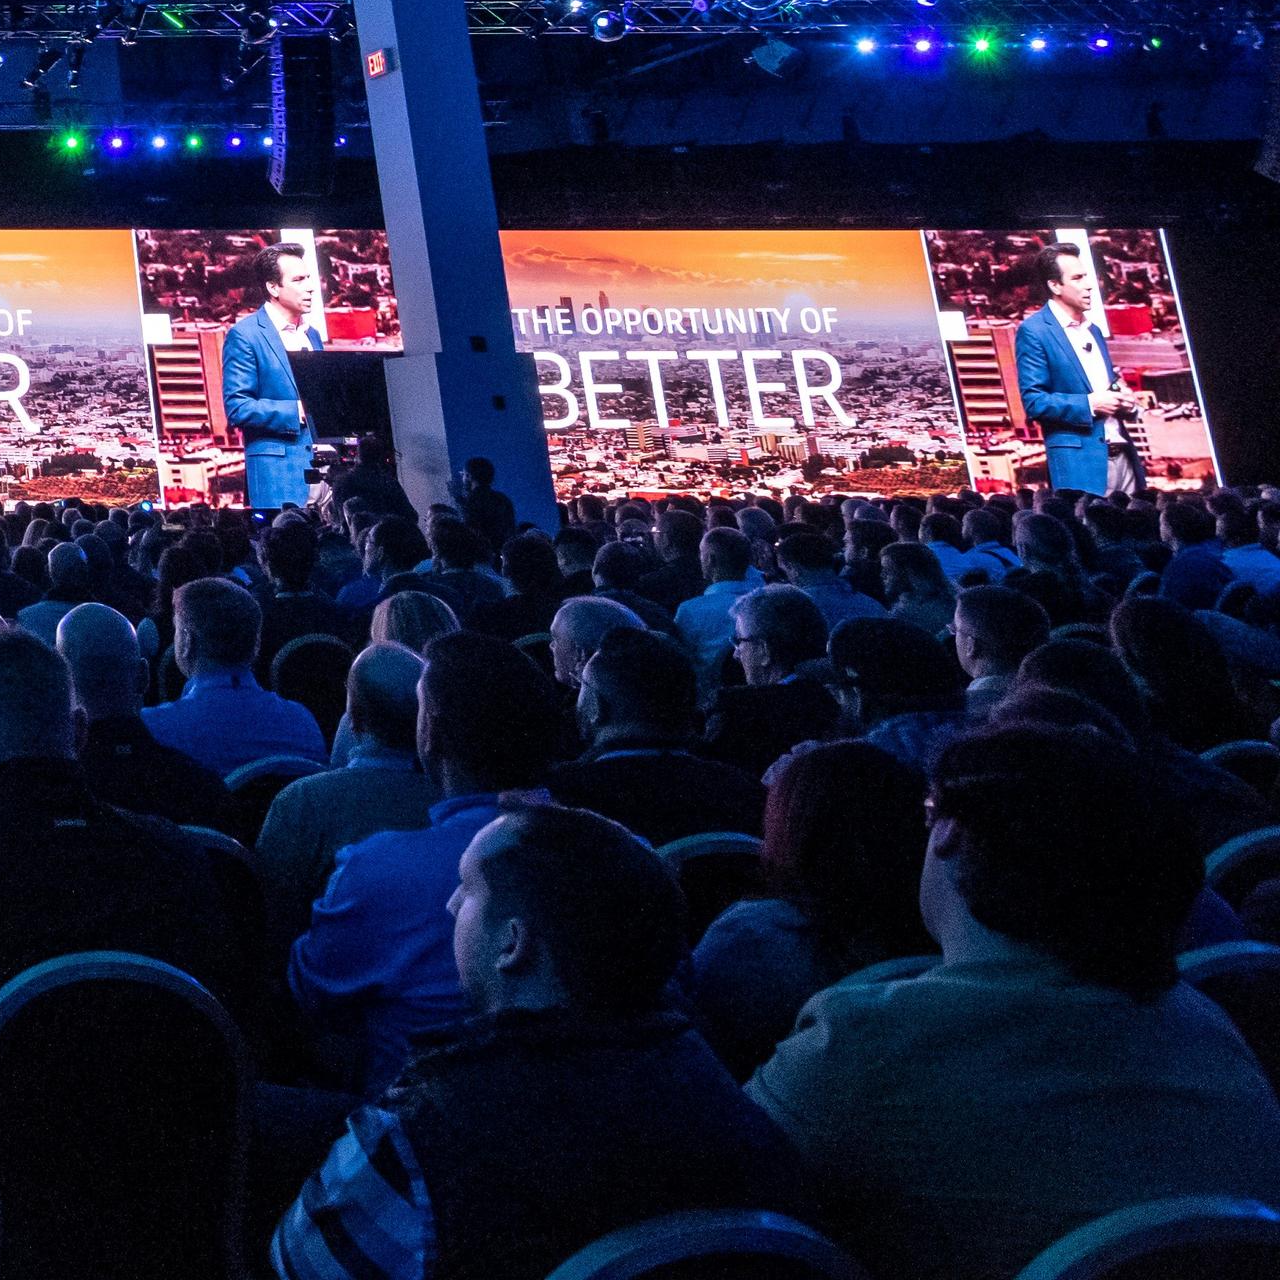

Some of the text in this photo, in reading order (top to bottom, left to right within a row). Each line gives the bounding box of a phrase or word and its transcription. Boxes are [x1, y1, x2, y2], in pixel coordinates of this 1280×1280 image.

[368, 52, 384, 76] EXIT
[511, 307, 838, 335] THE OPPORTUNITY OF
[533, 349, 856, 430] BETTER
